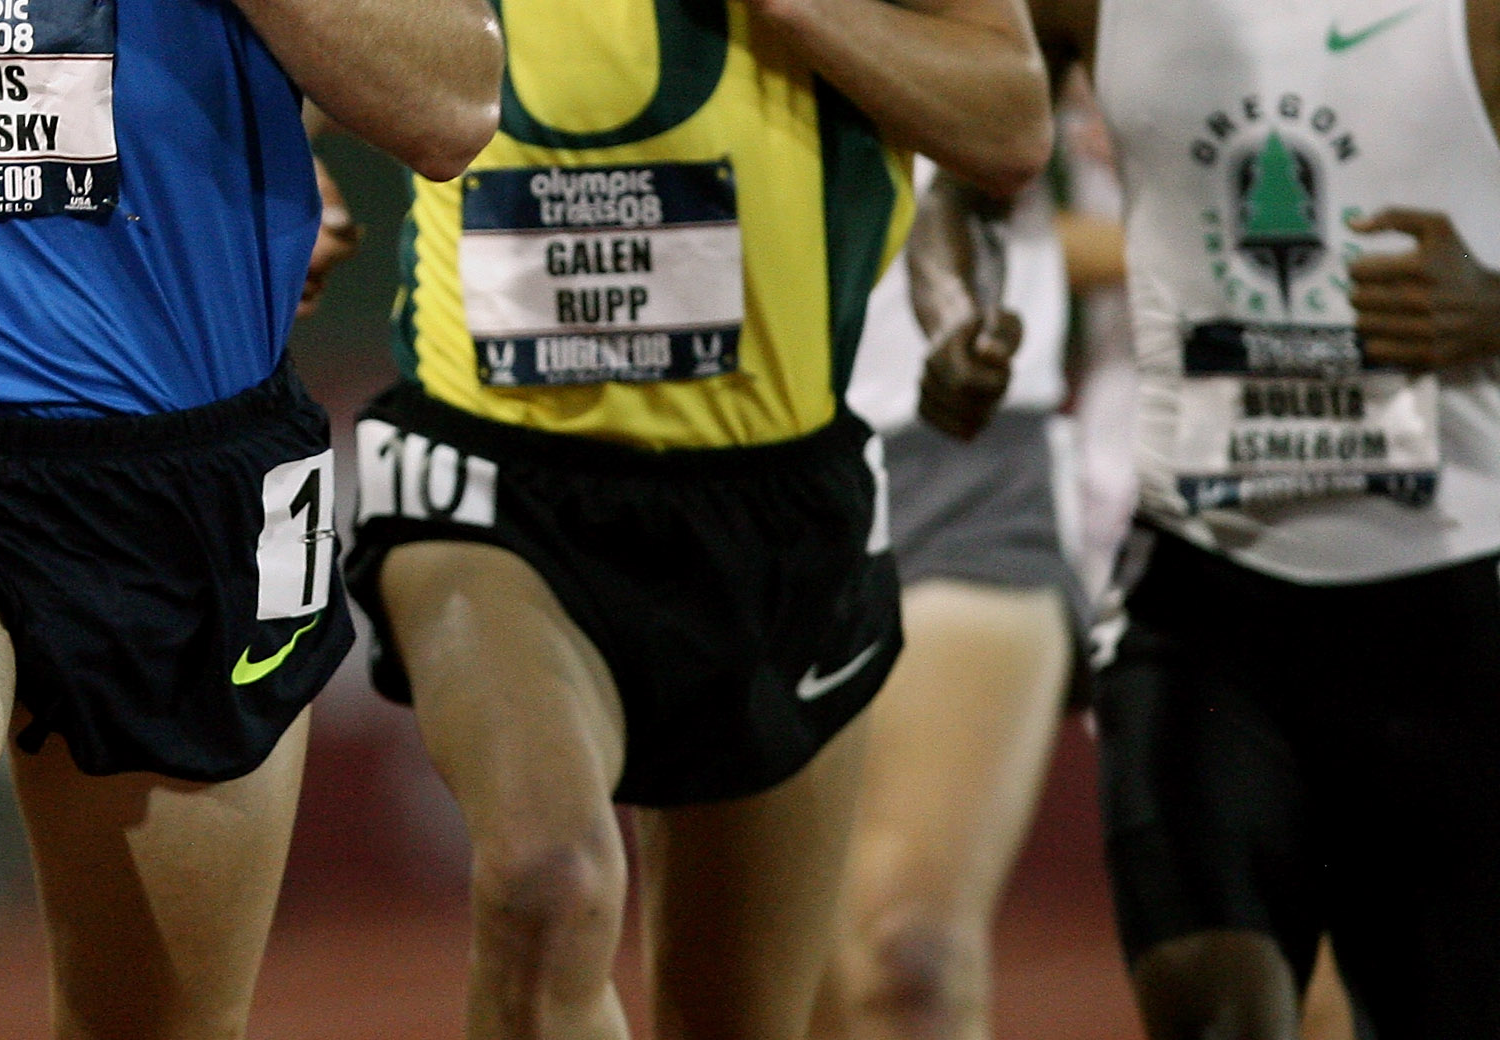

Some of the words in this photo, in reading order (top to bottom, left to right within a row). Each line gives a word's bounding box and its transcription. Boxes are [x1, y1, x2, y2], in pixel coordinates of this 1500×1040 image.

[1188, 92, 1358, 166] OREGON
[546, 237, 651, 277] GALEN
[556, 285, 648, 324] RUPP
[289, 467, 321, 607] 1
